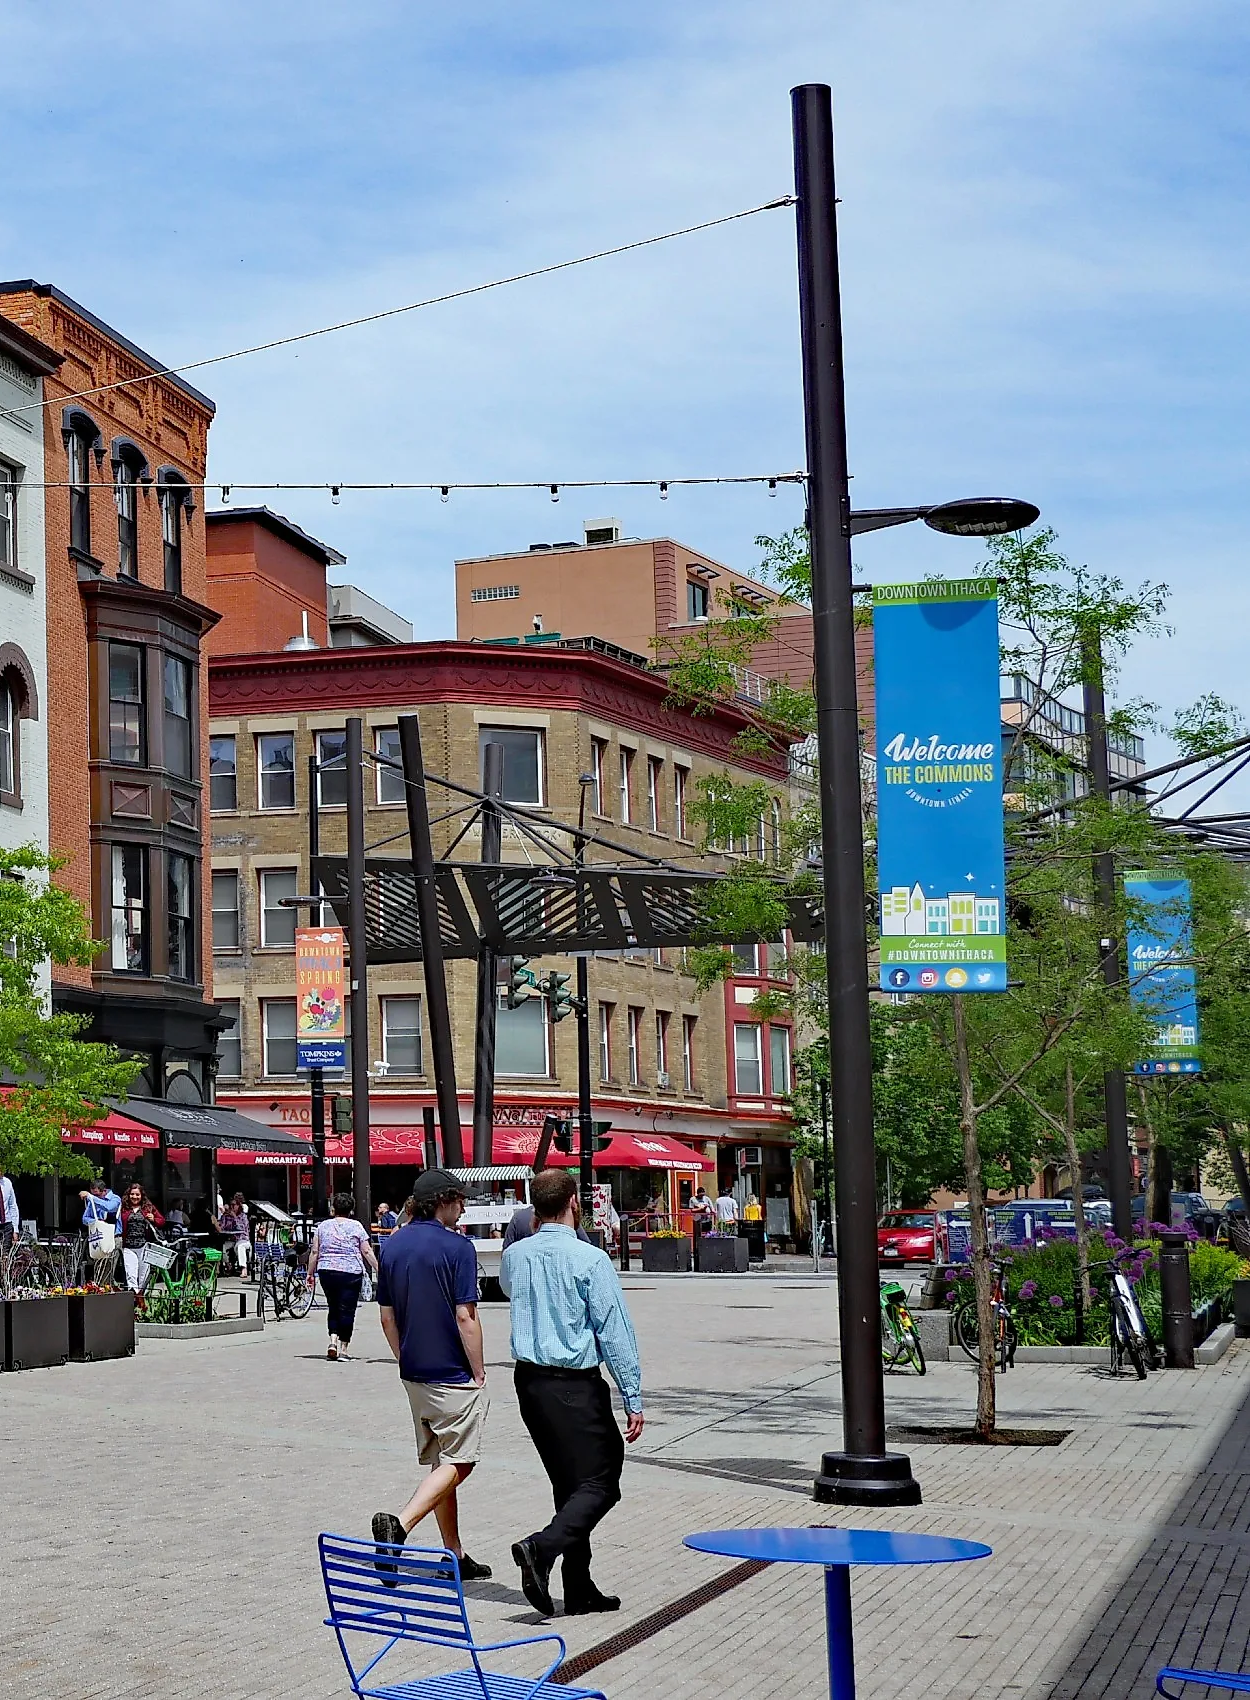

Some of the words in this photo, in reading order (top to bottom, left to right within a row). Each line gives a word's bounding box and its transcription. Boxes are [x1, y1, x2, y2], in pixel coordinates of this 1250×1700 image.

[877, 583, 947, 600] DOWNTOWN
[950, 581, 991, 595] ITHACA
[883, 733, 994, 762] Welcome
[884, 766, 911, 784] THE
[915, 764, 993, 784] COMMONS
[905, 788, 946, 807] DOWNTOWN
[948, 787, 973, 806] ITHACA
[909, 938, 945, 949] Connect
[946, 938, 966, 948] with
[299, 947, 340, 957] DOWNTOWN
[887, 950, 994, 961] #DOWNTOWNITHACA
[300, 971, 340, 984] SPRING
[300, 1050, 335, 1059] TOMPKINS
[255, 1156, 307, 1164] MARGARITAS
